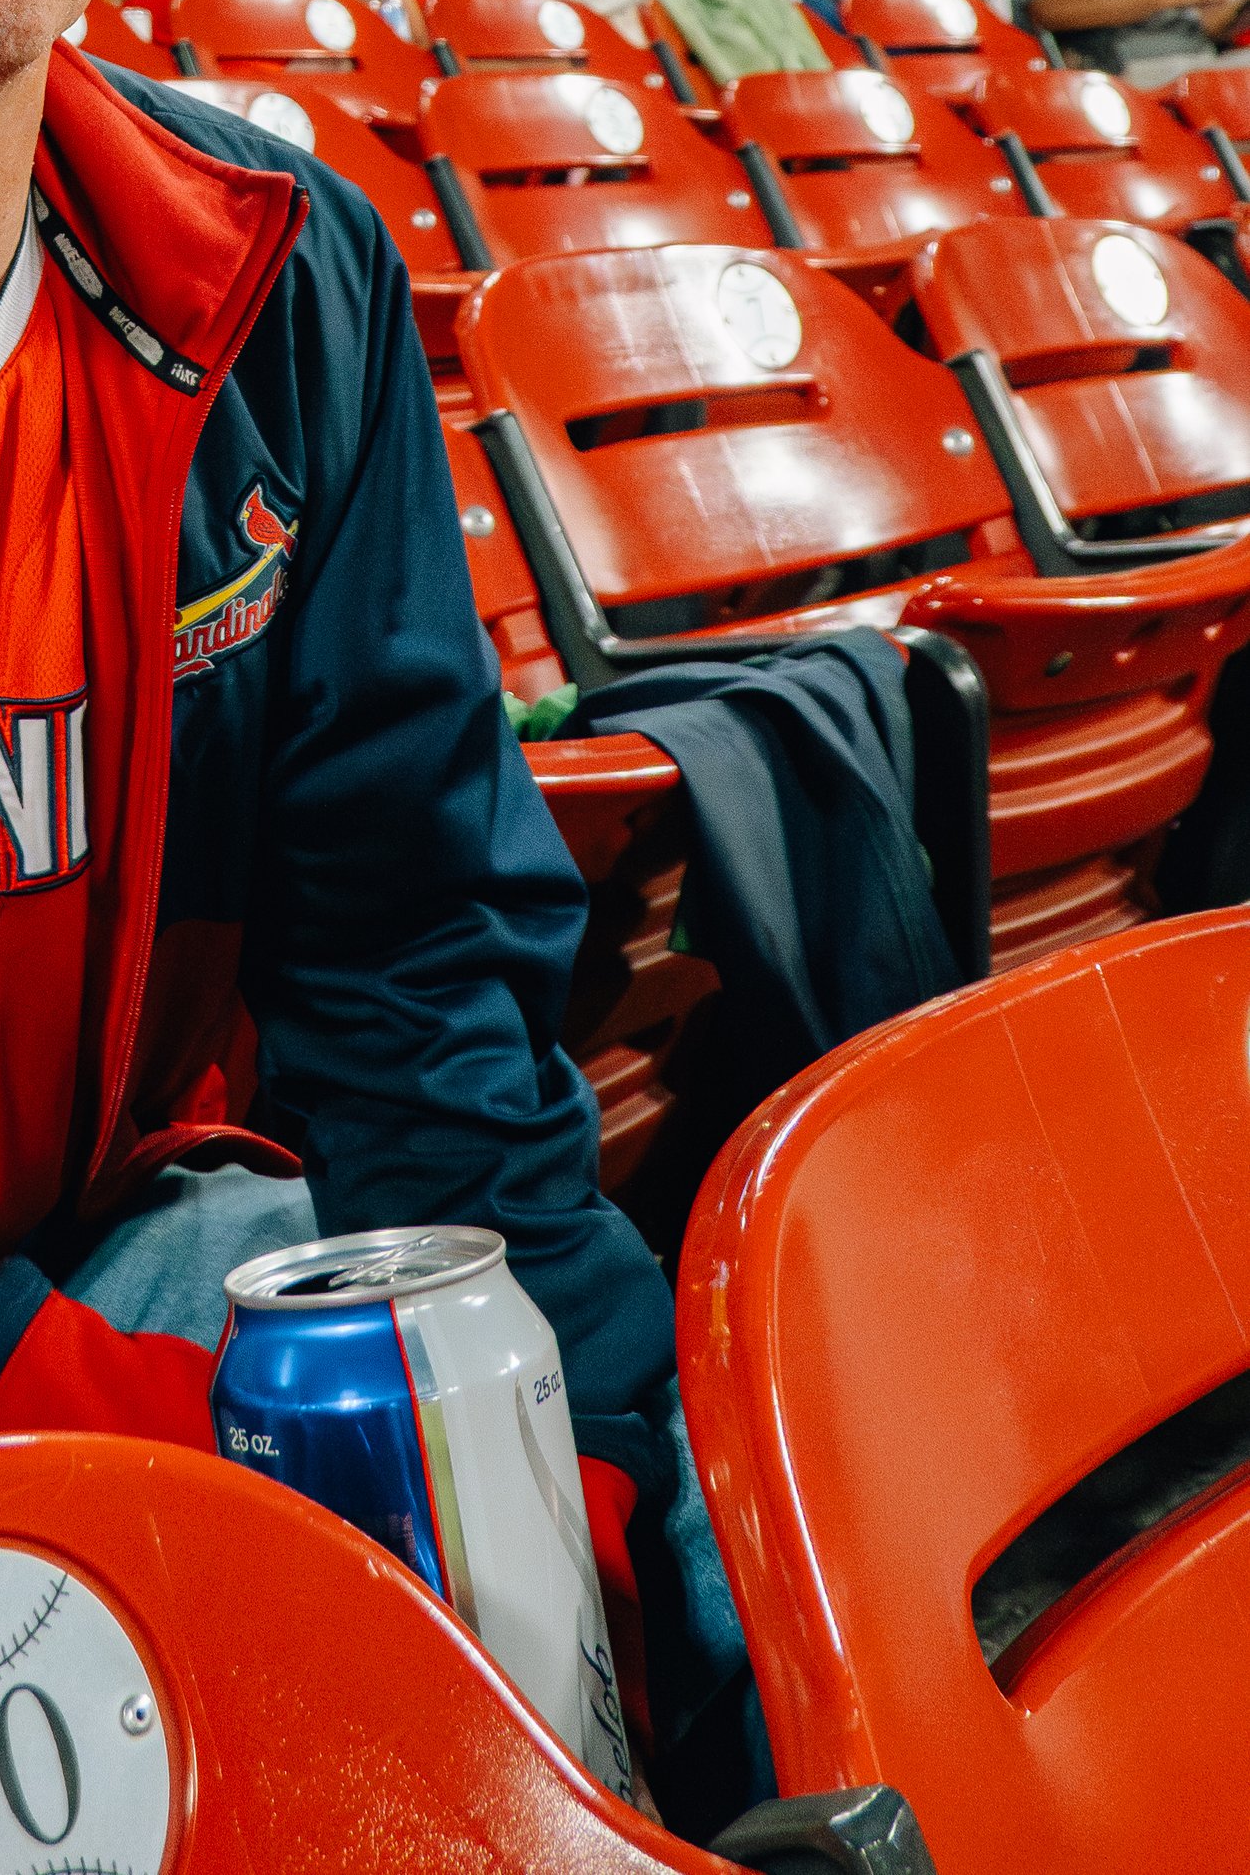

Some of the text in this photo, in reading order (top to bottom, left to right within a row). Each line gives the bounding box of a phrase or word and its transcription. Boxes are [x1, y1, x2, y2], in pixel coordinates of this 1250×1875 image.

[108, 305, 136, 335] NIKE
[170, 362, 200, 387] NIKE
[173, 566, 290, 682] ardinal
[533, 1374, 551, 1405] 25
[228, 1426, 280, 1456] 25 OZ.
